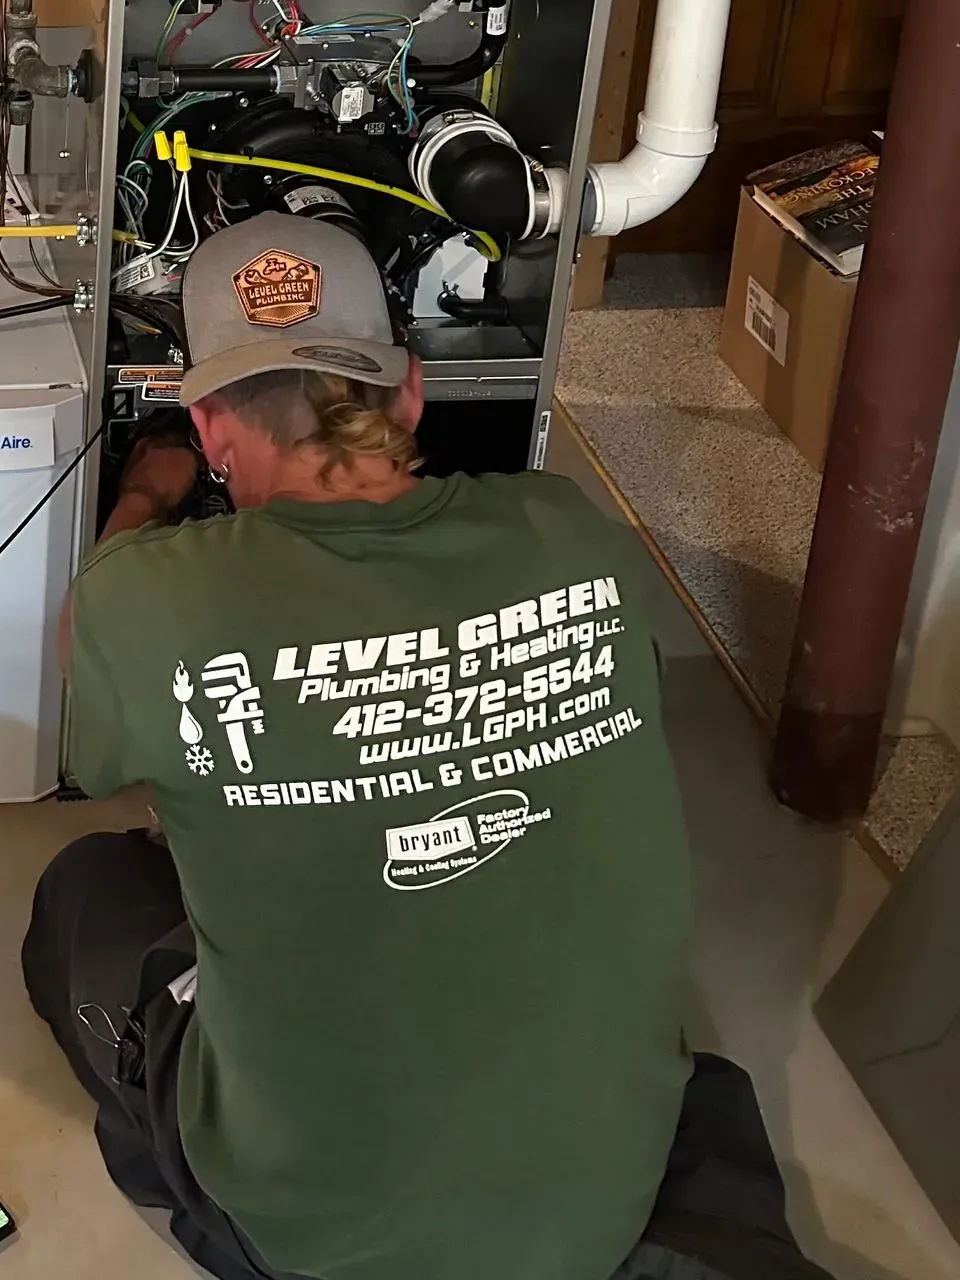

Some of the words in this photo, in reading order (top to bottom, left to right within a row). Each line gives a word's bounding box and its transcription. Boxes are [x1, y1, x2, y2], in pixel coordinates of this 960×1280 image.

[832, 185, 866, 201] THE
[249, 285, 278, 299] LEVEL
[279, 282, 309, 293] GREEN
[256, 293, 305, 305] PLUMBING
[272, 627, 450, 681] LEVEL
[457, 577, 621, 652] GREEN
[298, 663, 450, 704] Plumbing
[459, 653, 481, 679] &
[490, 621, 595, 672] Heating
[595, 617, 625, 637] LLC.
[332, 644, 615, 739] 412-372-5544
[359, 686, 610, 765] www.LGPH.com
[224, 768, 434, 807] RESIDENTIAL
[439, 762, 463, 788] &
[471, 707, 643, 782] COMMERCIAL
[477, 805, 529, 825] Factory
[479, 808, 552, 834] Authorized
[399, 826, 462, 852] bryant
[480, 827, 527, 844] Dealer
[391, 868, 417, 876] Heating
[426, 861, 449, 871] Cooling
[450, 856, 477, 868] Systems
